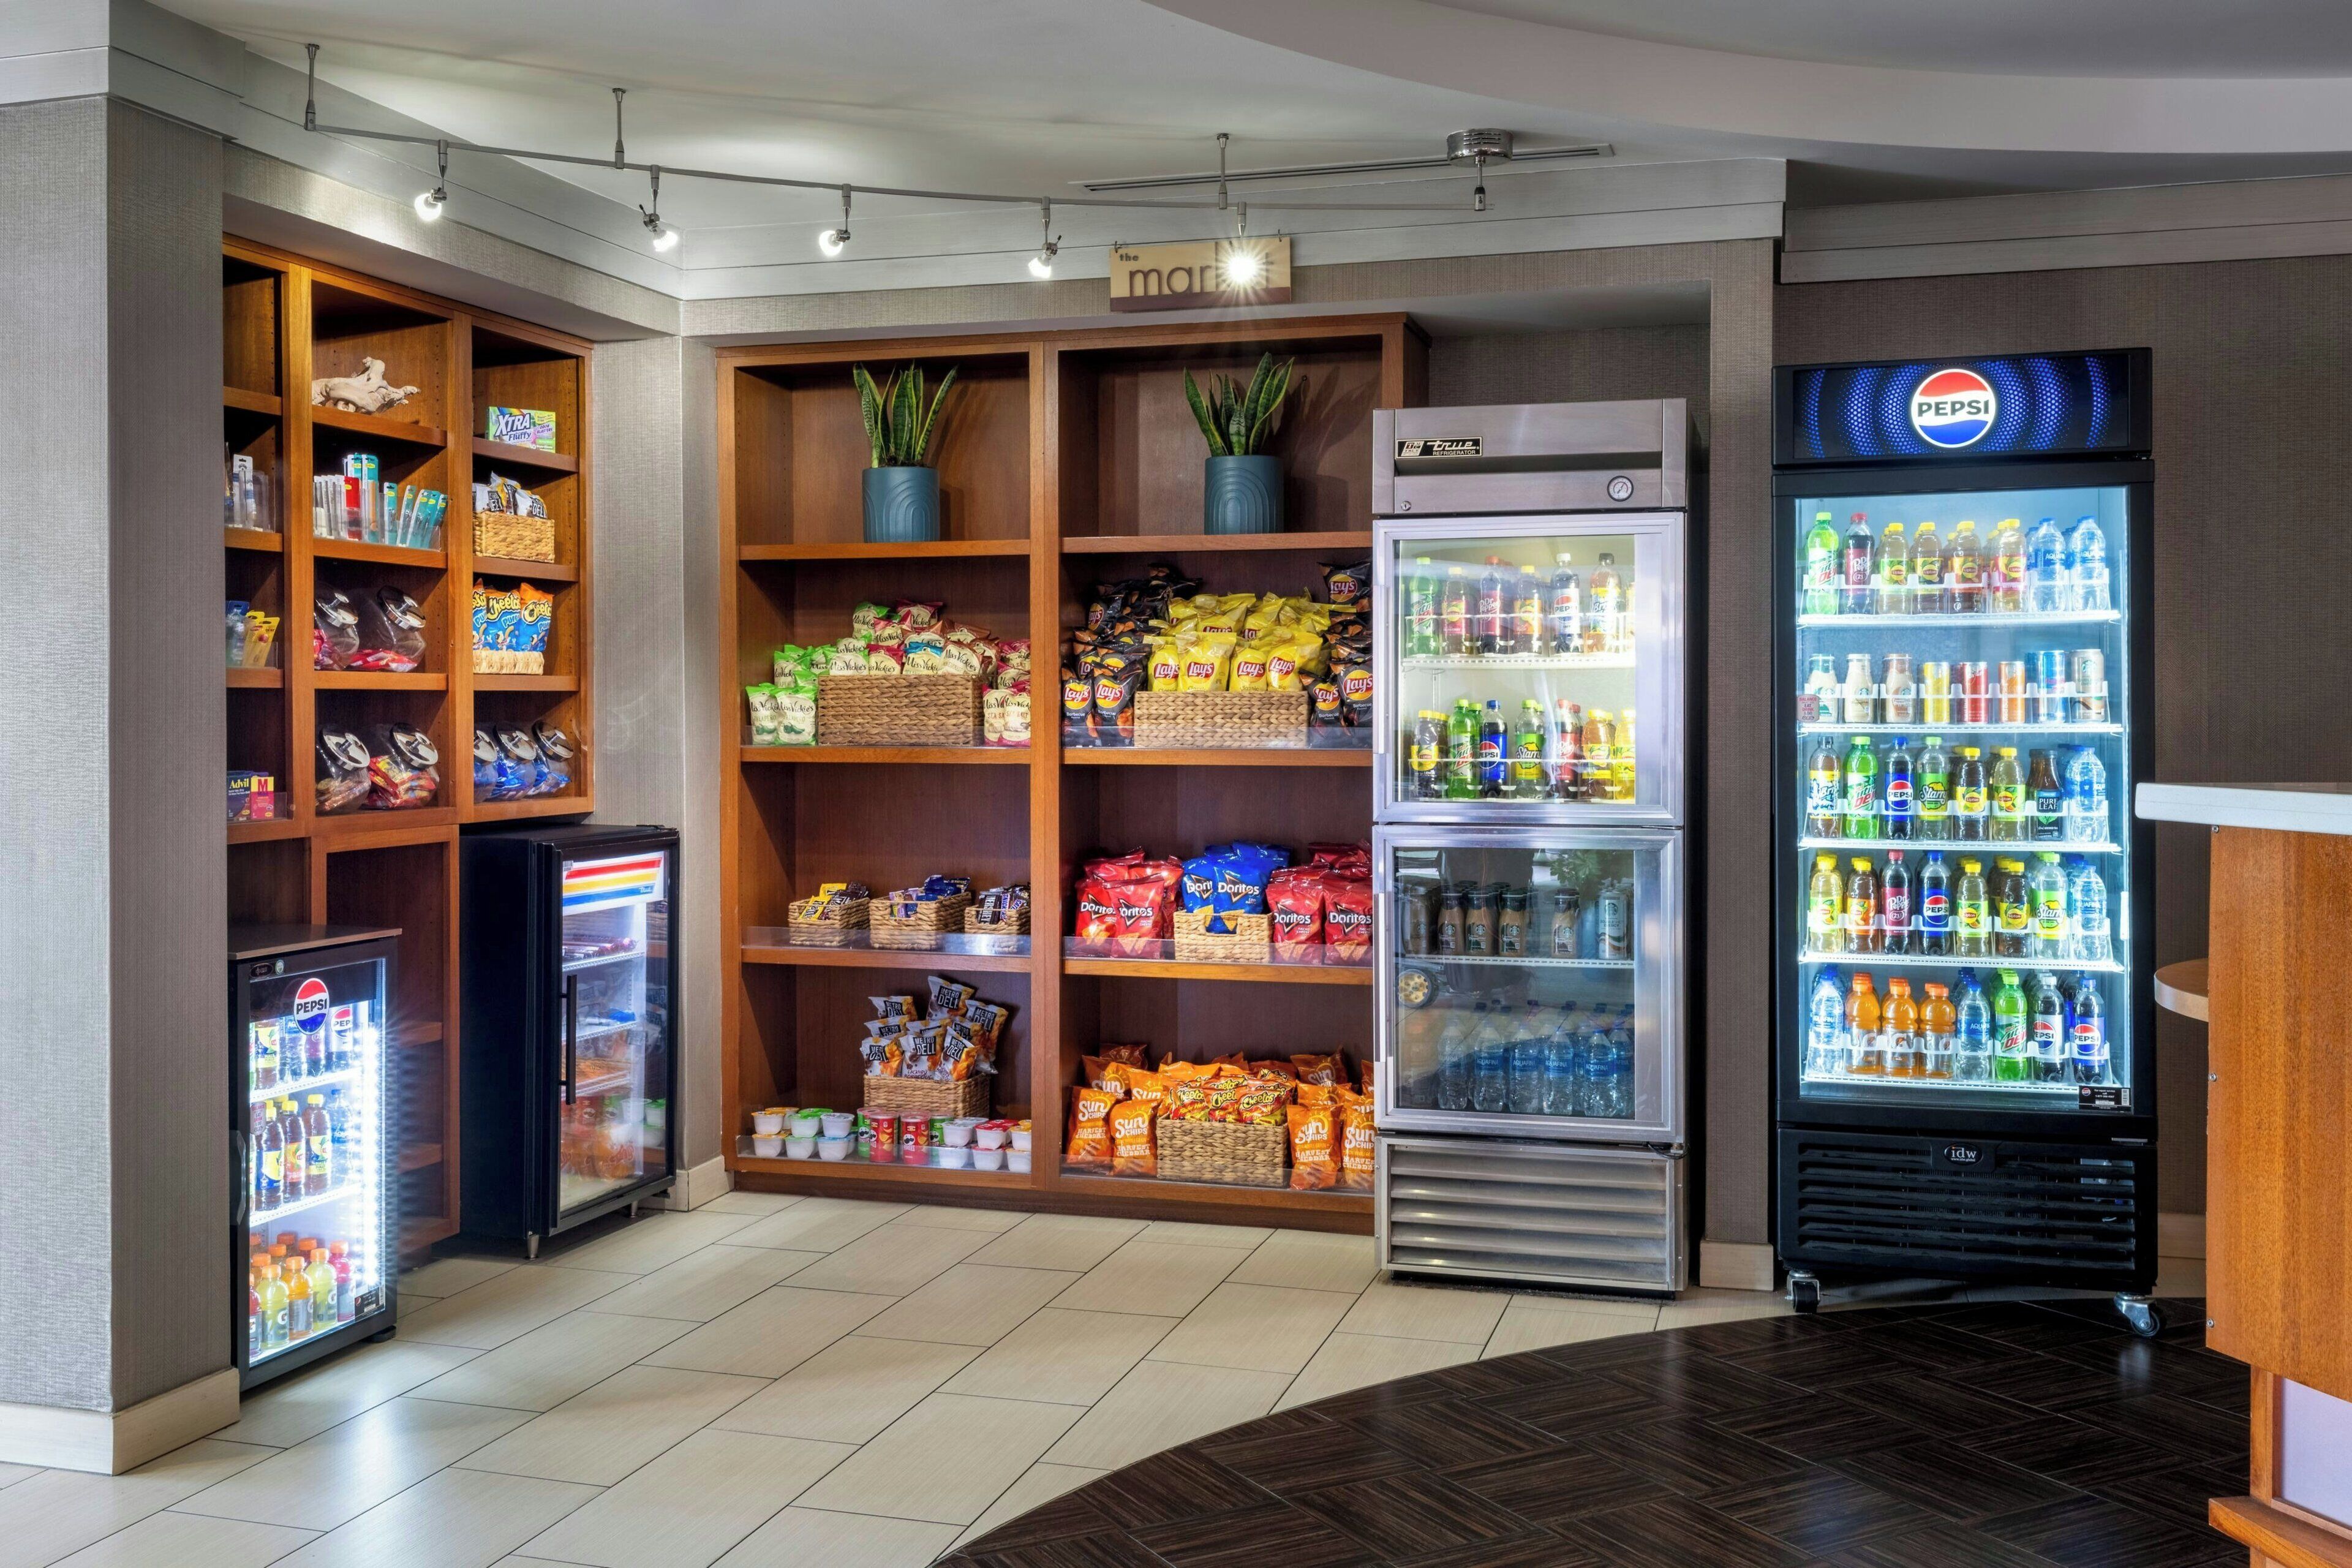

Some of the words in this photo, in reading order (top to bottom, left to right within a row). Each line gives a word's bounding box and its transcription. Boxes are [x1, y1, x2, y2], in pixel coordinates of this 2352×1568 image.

[1119, 253, 1139, 262] the
[1129, 241, 1275, 297] markt
[1917, 399, 1990, 417] PEPSI
[494, 413, 531, 437] XTRA
[508, 431, 531, 441] Fluffy
[844, 658, 867, 673] Vickie's
[875, 660, 895, 674] Vickie's
[1188, 662, 1213, 677] Lay's
[1238, 662, 1264, 677] Lay's
[1269, 657, 1294, 673] Lay's
[1346, 676, 1373, 693] Lay's
[1065, 687, 1089, 703] Lay's
[1096, 684, 1121, 701] Lay's
[1315, 686, 1339, 703] Lay's
[790, 700, 814, 715] Vickie's
[229, 778, 249, 789] Advil
[1218, 882, 1259, 895] Doritos
[1329, 911, 1372, 924] Doritos
[941, 987, 959, 998] METRO
[296, 998, 328, 1014] PEPSI
[938, 995, 958, 1009] DELI
[976, 1006, 995, 1017] METRO
[918, 1043, 935, 1055] DELI
[947, 1044, 963, 1060] DELI
[1242, 1092, 1275, 1109] Cheetos
[1078, 1099, 1109, 1121] Sun
[1115, 1115, 1148, 1139] Sun
[1295, 1120, 1329, 1144] Sun
[1951, 1146, 1977, 1158] idw
